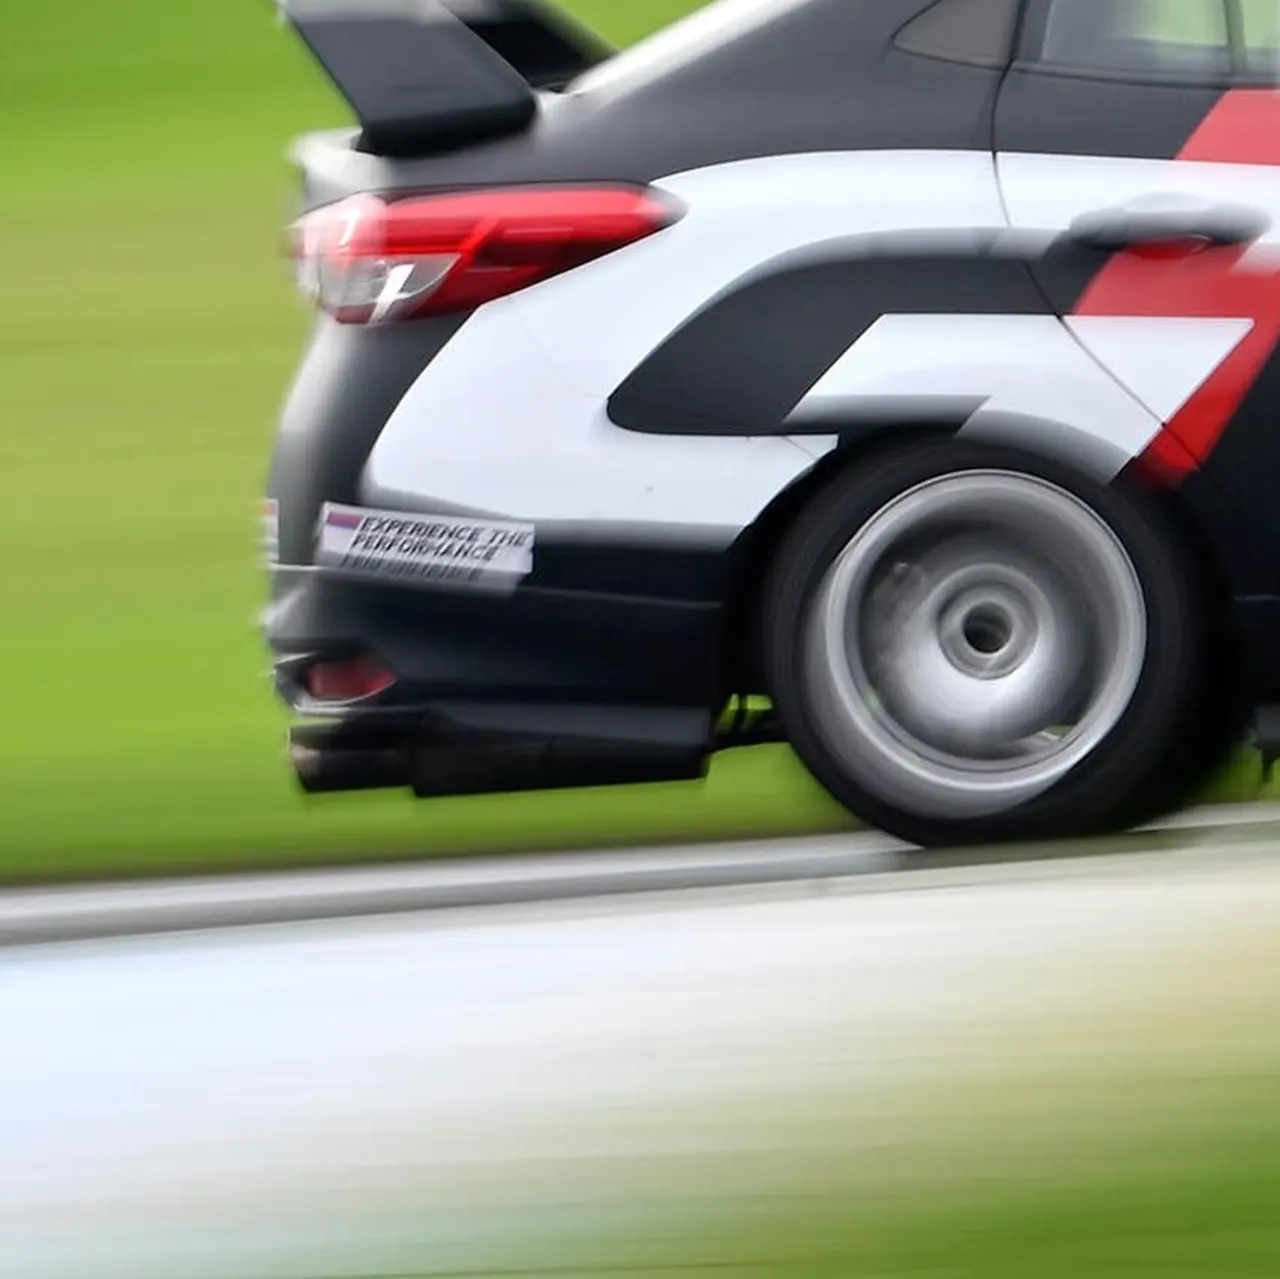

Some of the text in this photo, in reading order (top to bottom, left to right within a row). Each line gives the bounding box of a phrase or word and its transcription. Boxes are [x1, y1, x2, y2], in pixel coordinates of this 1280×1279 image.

[360, 517, 532, 546] EXPERIENCE THE
[352, 533, 498, 561] PERFORMANCE
